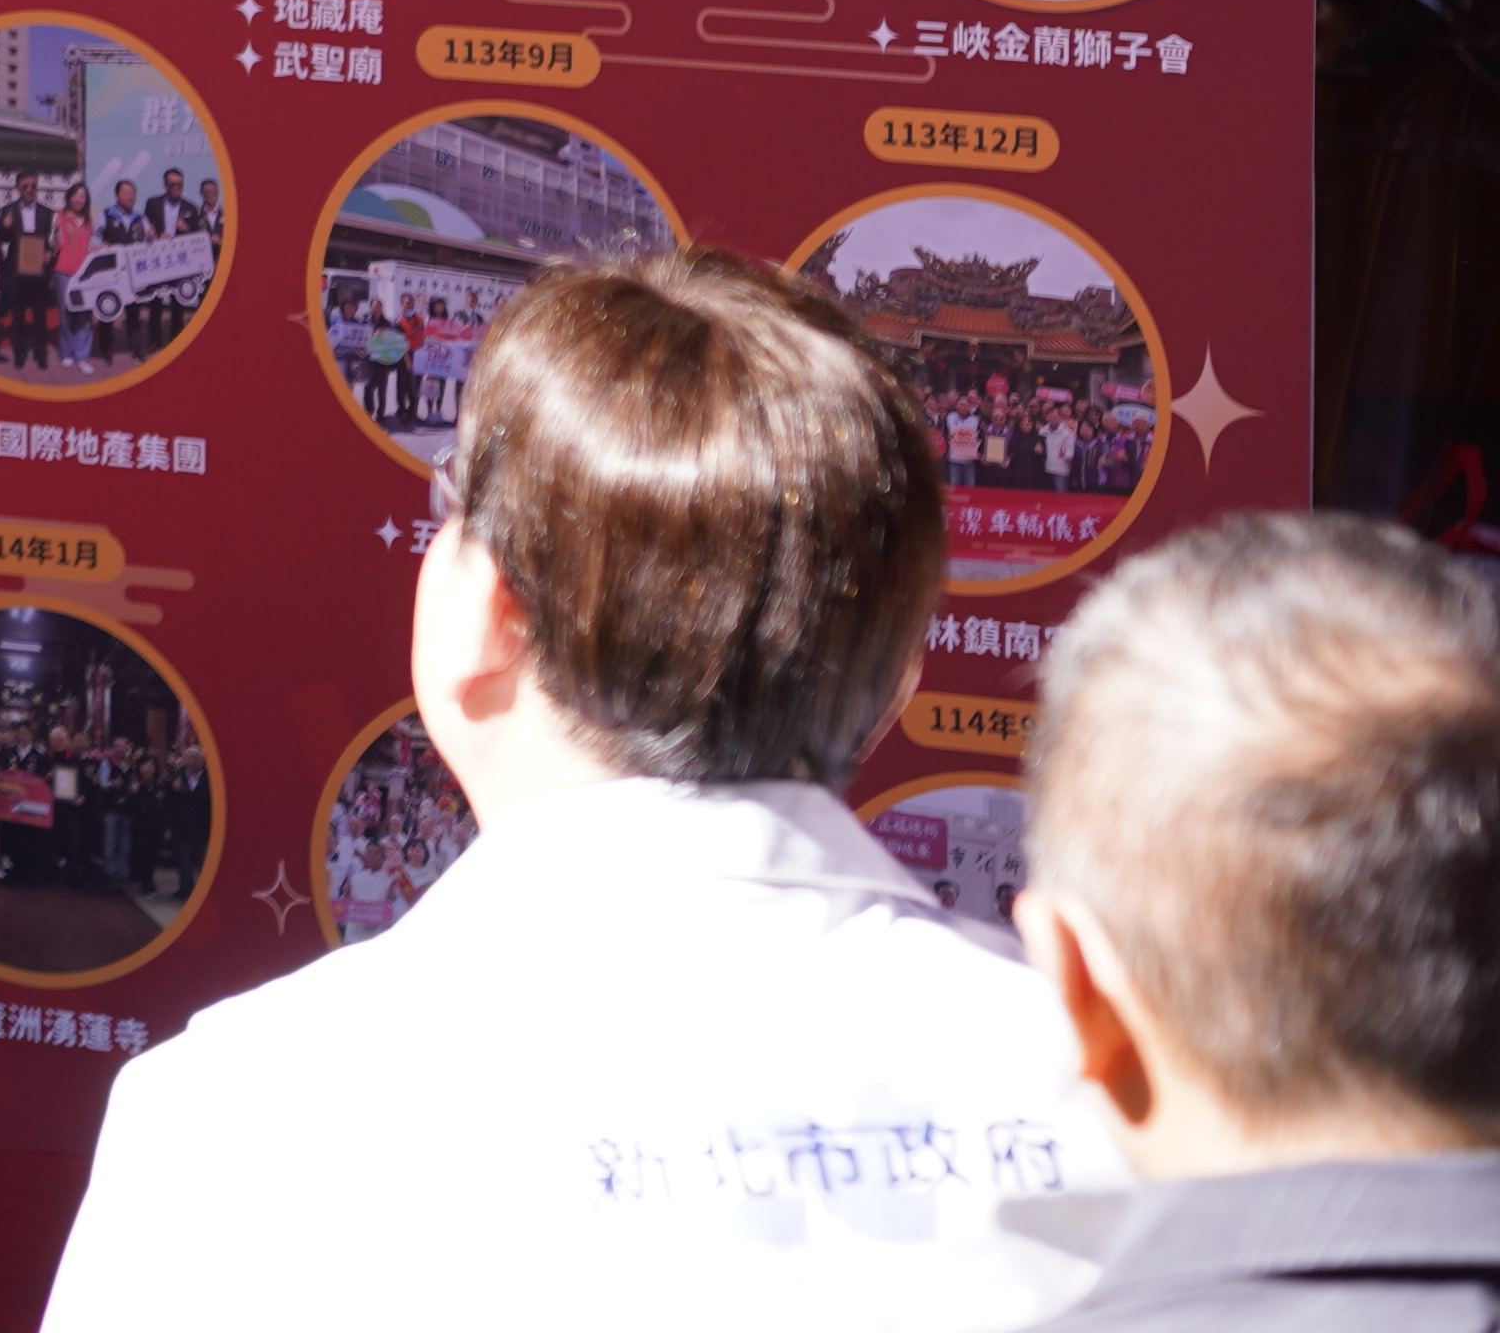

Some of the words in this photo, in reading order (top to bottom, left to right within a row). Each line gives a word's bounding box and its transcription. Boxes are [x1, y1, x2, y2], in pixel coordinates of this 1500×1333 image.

[273, 41, 384, 86] 武聖廟
[442, 38, 574, 73] 113年9月
[913, 19, 1193, 75] 三峽金蘭獅子會
[880, 120, 1040, 159] 113年12月
[926, 613, 1060, 662] 林鎮南
